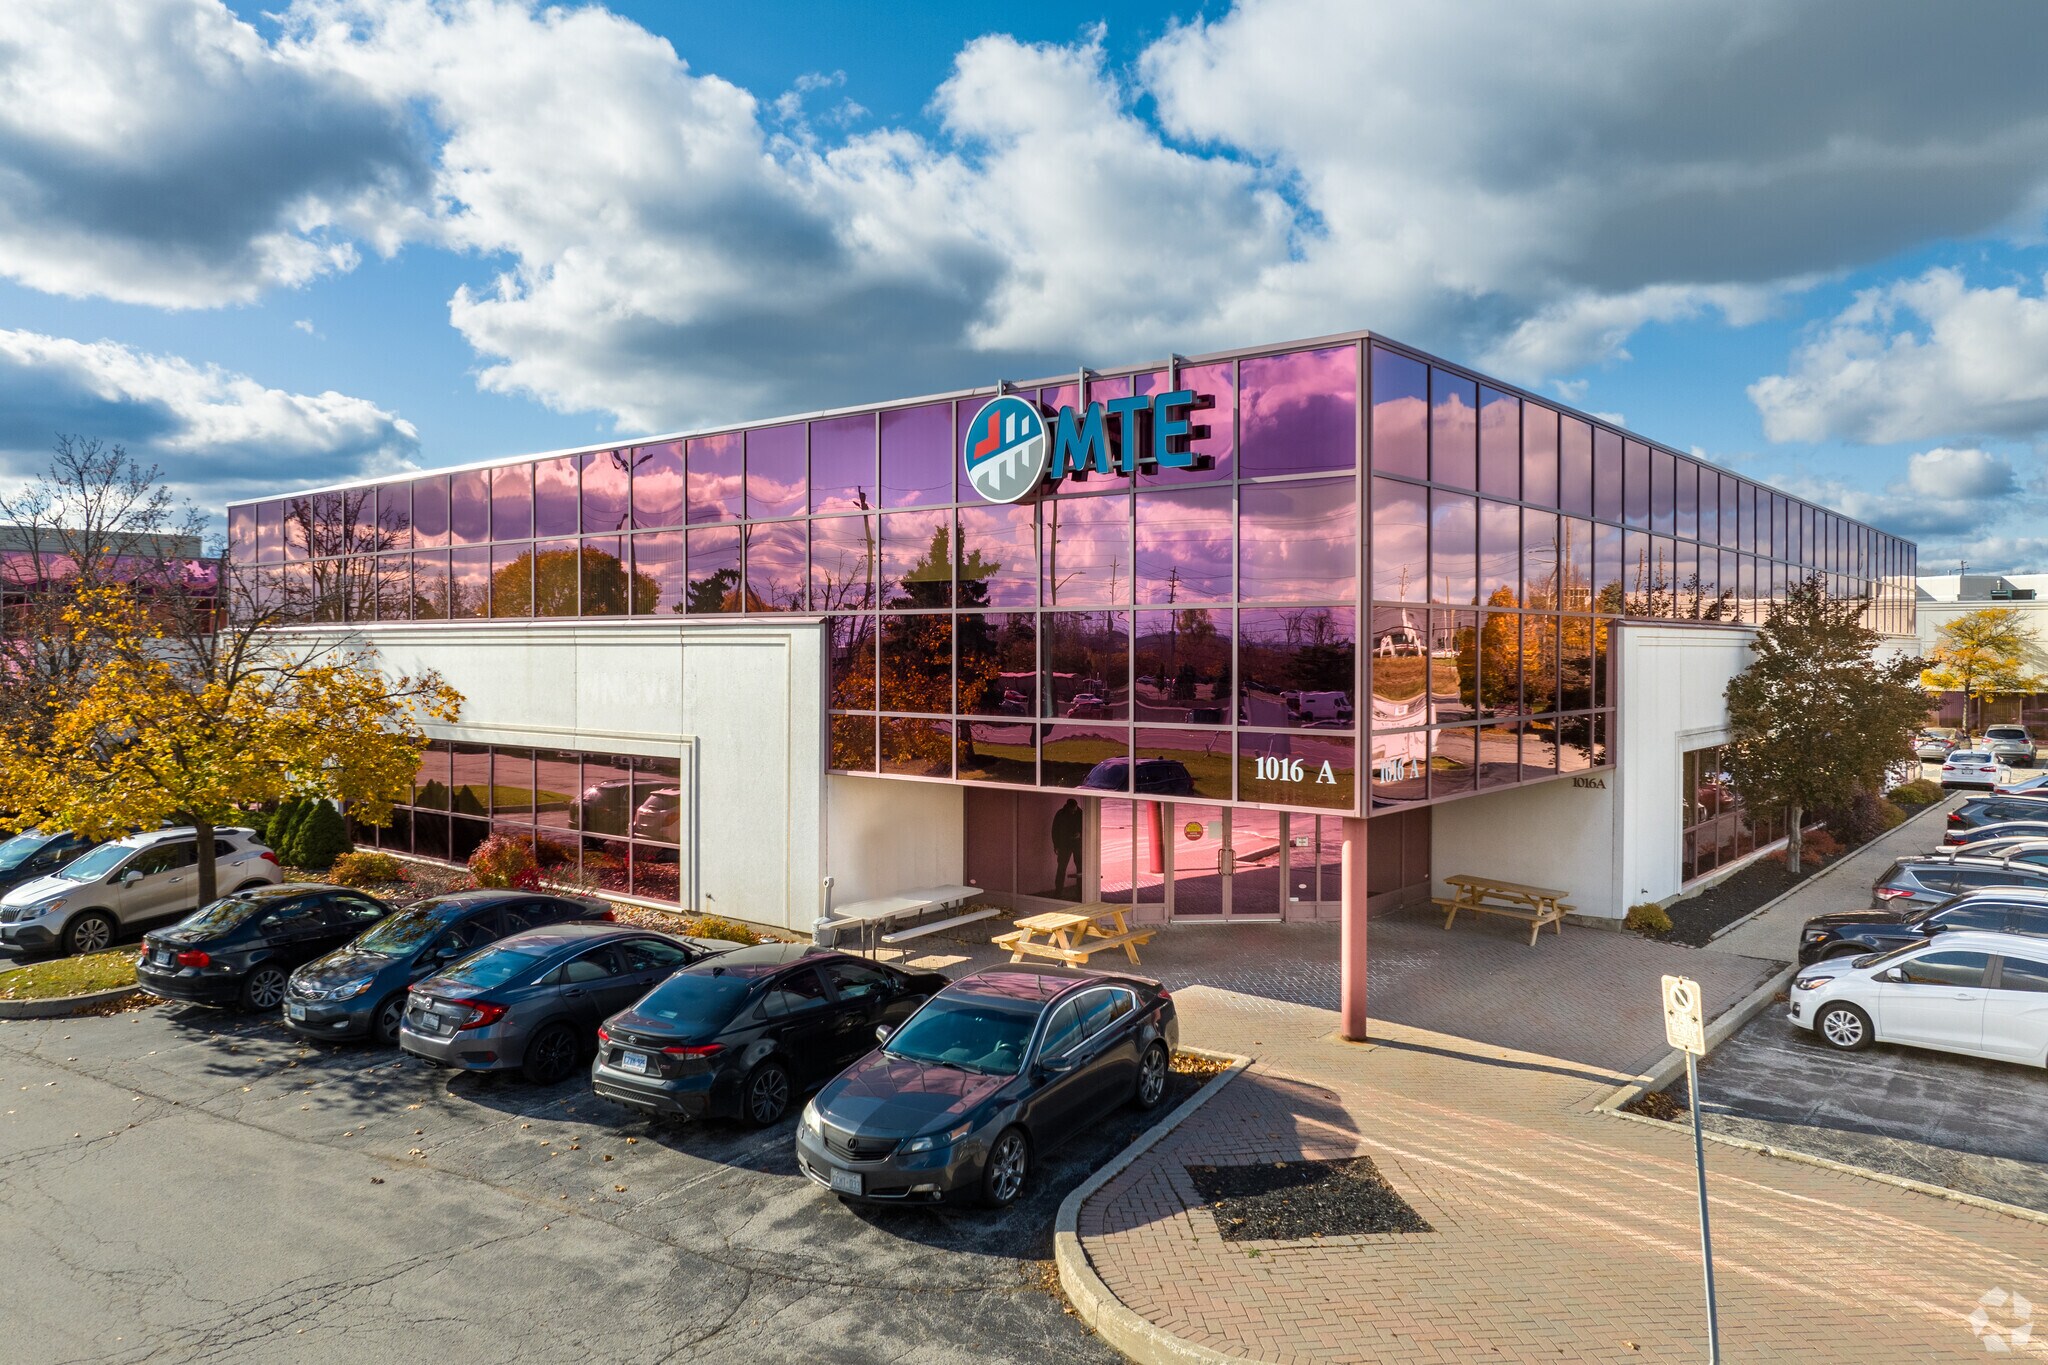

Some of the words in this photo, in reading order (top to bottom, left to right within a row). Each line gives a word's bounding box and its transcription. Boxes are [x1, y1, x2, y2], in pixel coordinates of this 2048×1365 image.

[1051, 389, 1196, 479] MTE
[1255, 756, 1304, 782] 1016
[1315, 760, 1337, 784] A
[1380, 758, 1404, 784] 1016
[1409, 757, 1420, 779] A
[1572, 777, 1606, 789] 1016A
